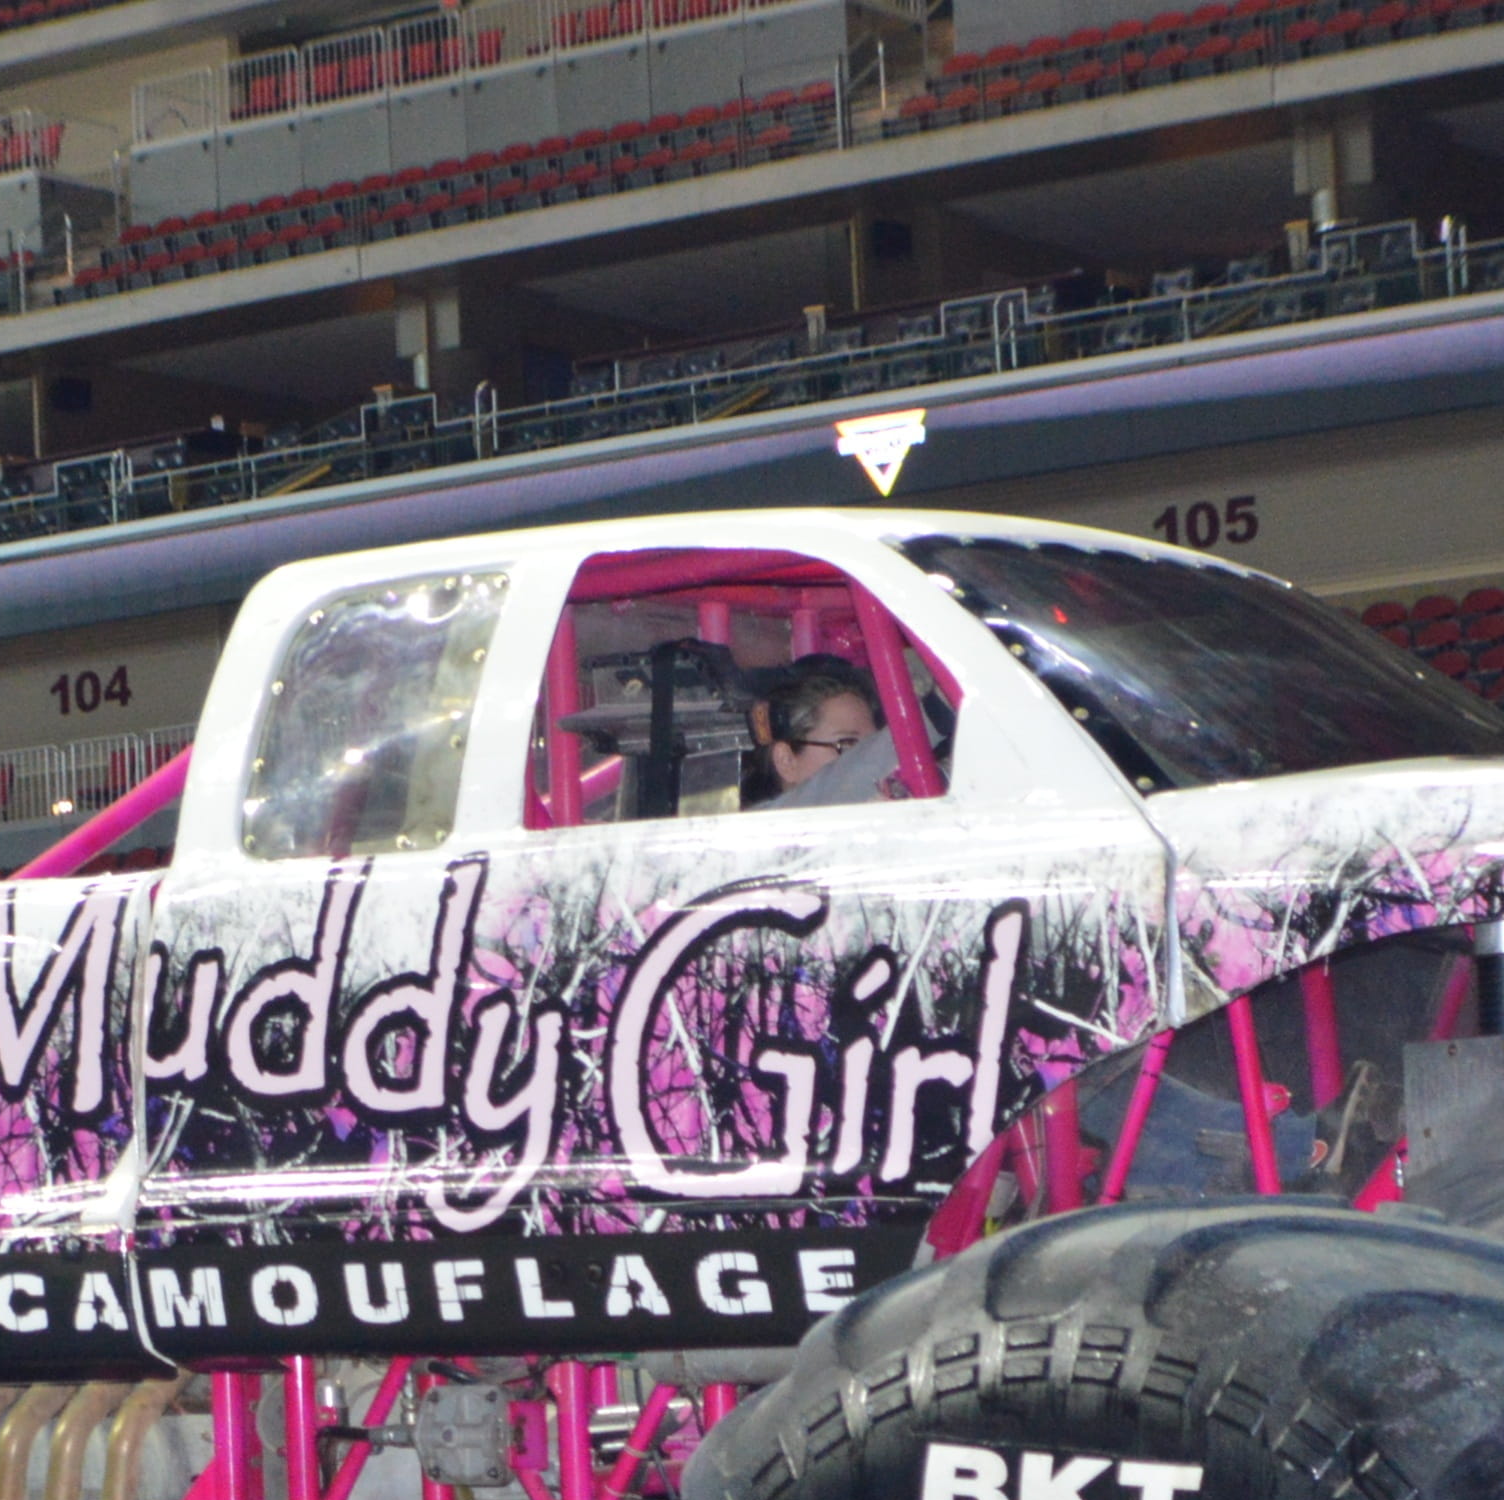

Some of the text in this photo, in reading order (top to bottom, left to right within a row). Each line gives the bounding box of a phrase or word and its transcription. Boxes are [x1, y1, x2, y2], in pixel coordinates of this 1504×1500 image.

[1153, 495, 1259, 549] 105
[50, 665, 133, 715] 104
[608, 882, 1028, 1198] Girl
